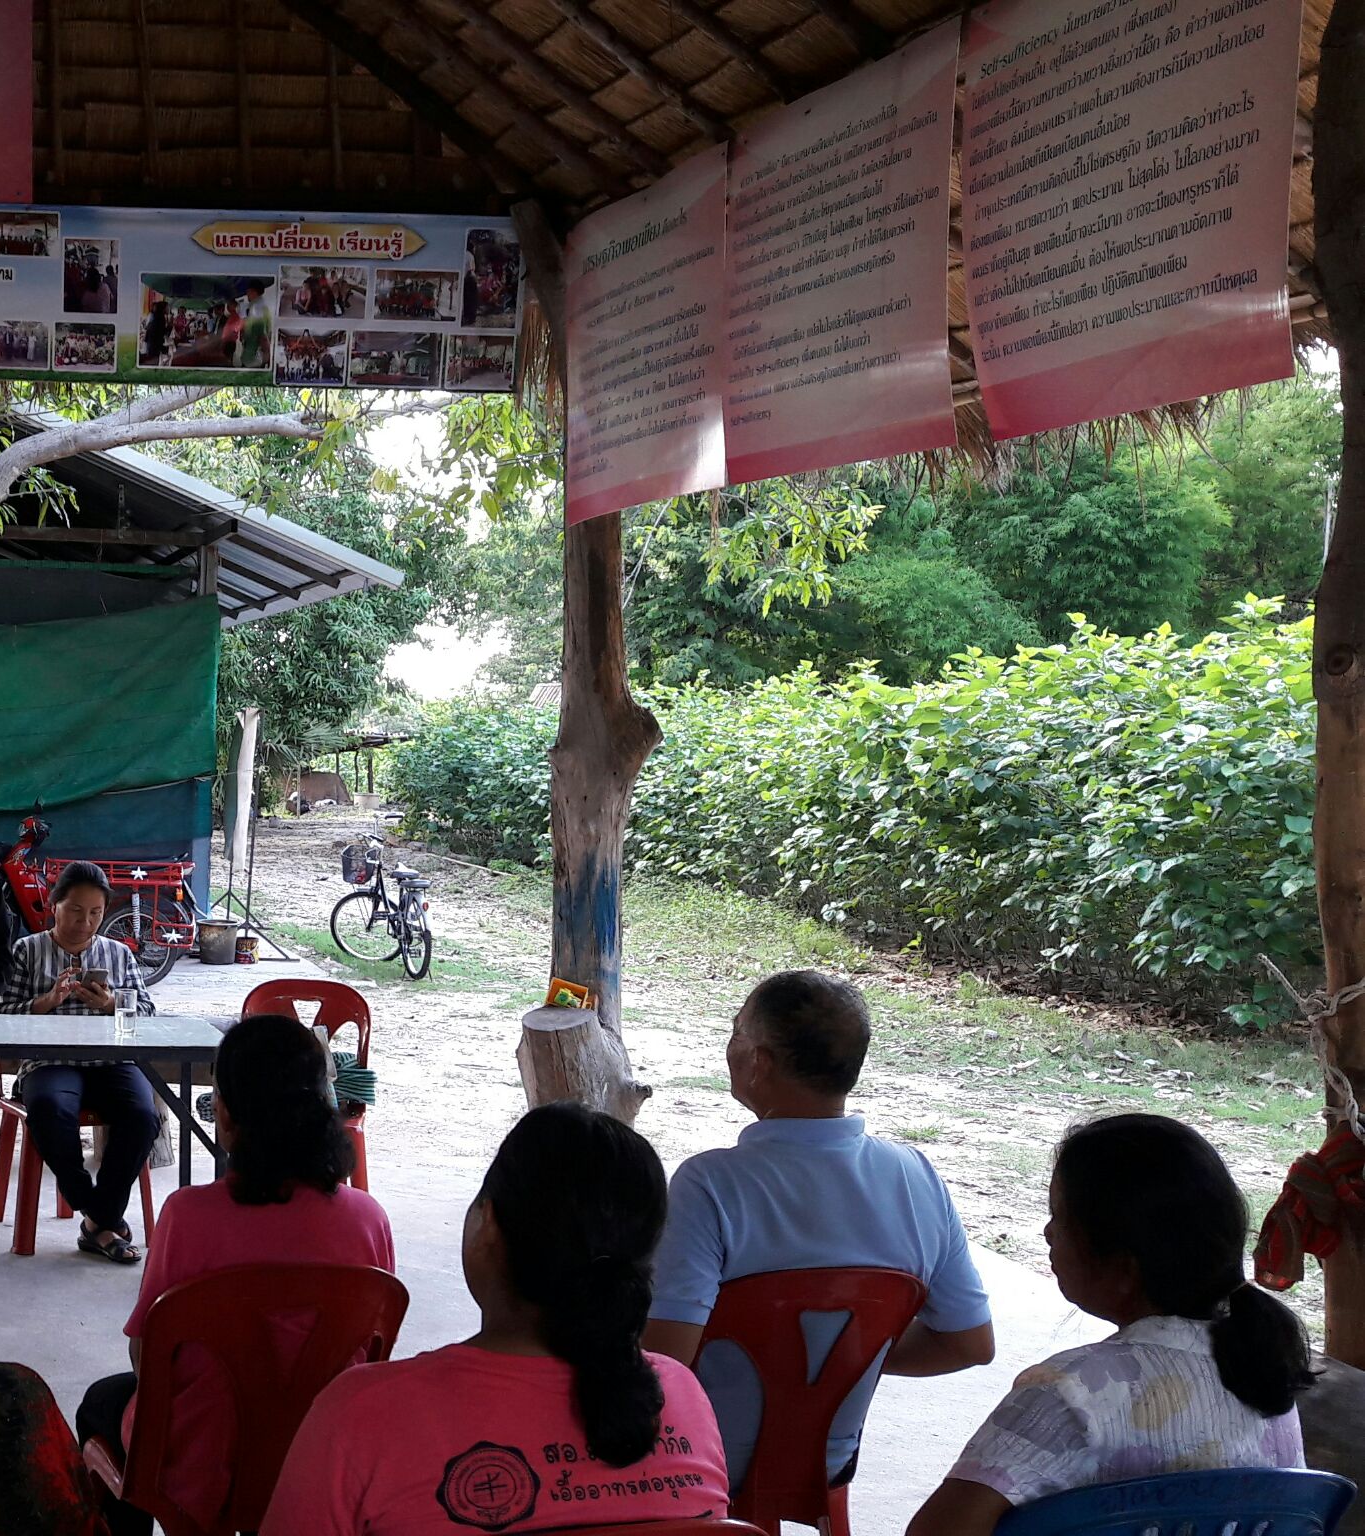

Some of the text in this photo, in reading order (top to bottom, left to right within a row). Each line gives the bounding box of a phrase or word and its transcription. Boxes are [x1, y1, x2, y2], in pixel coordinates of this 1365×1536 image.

[214, 223, 404, 259] แลกเปลี่ยน เรียนรู้
